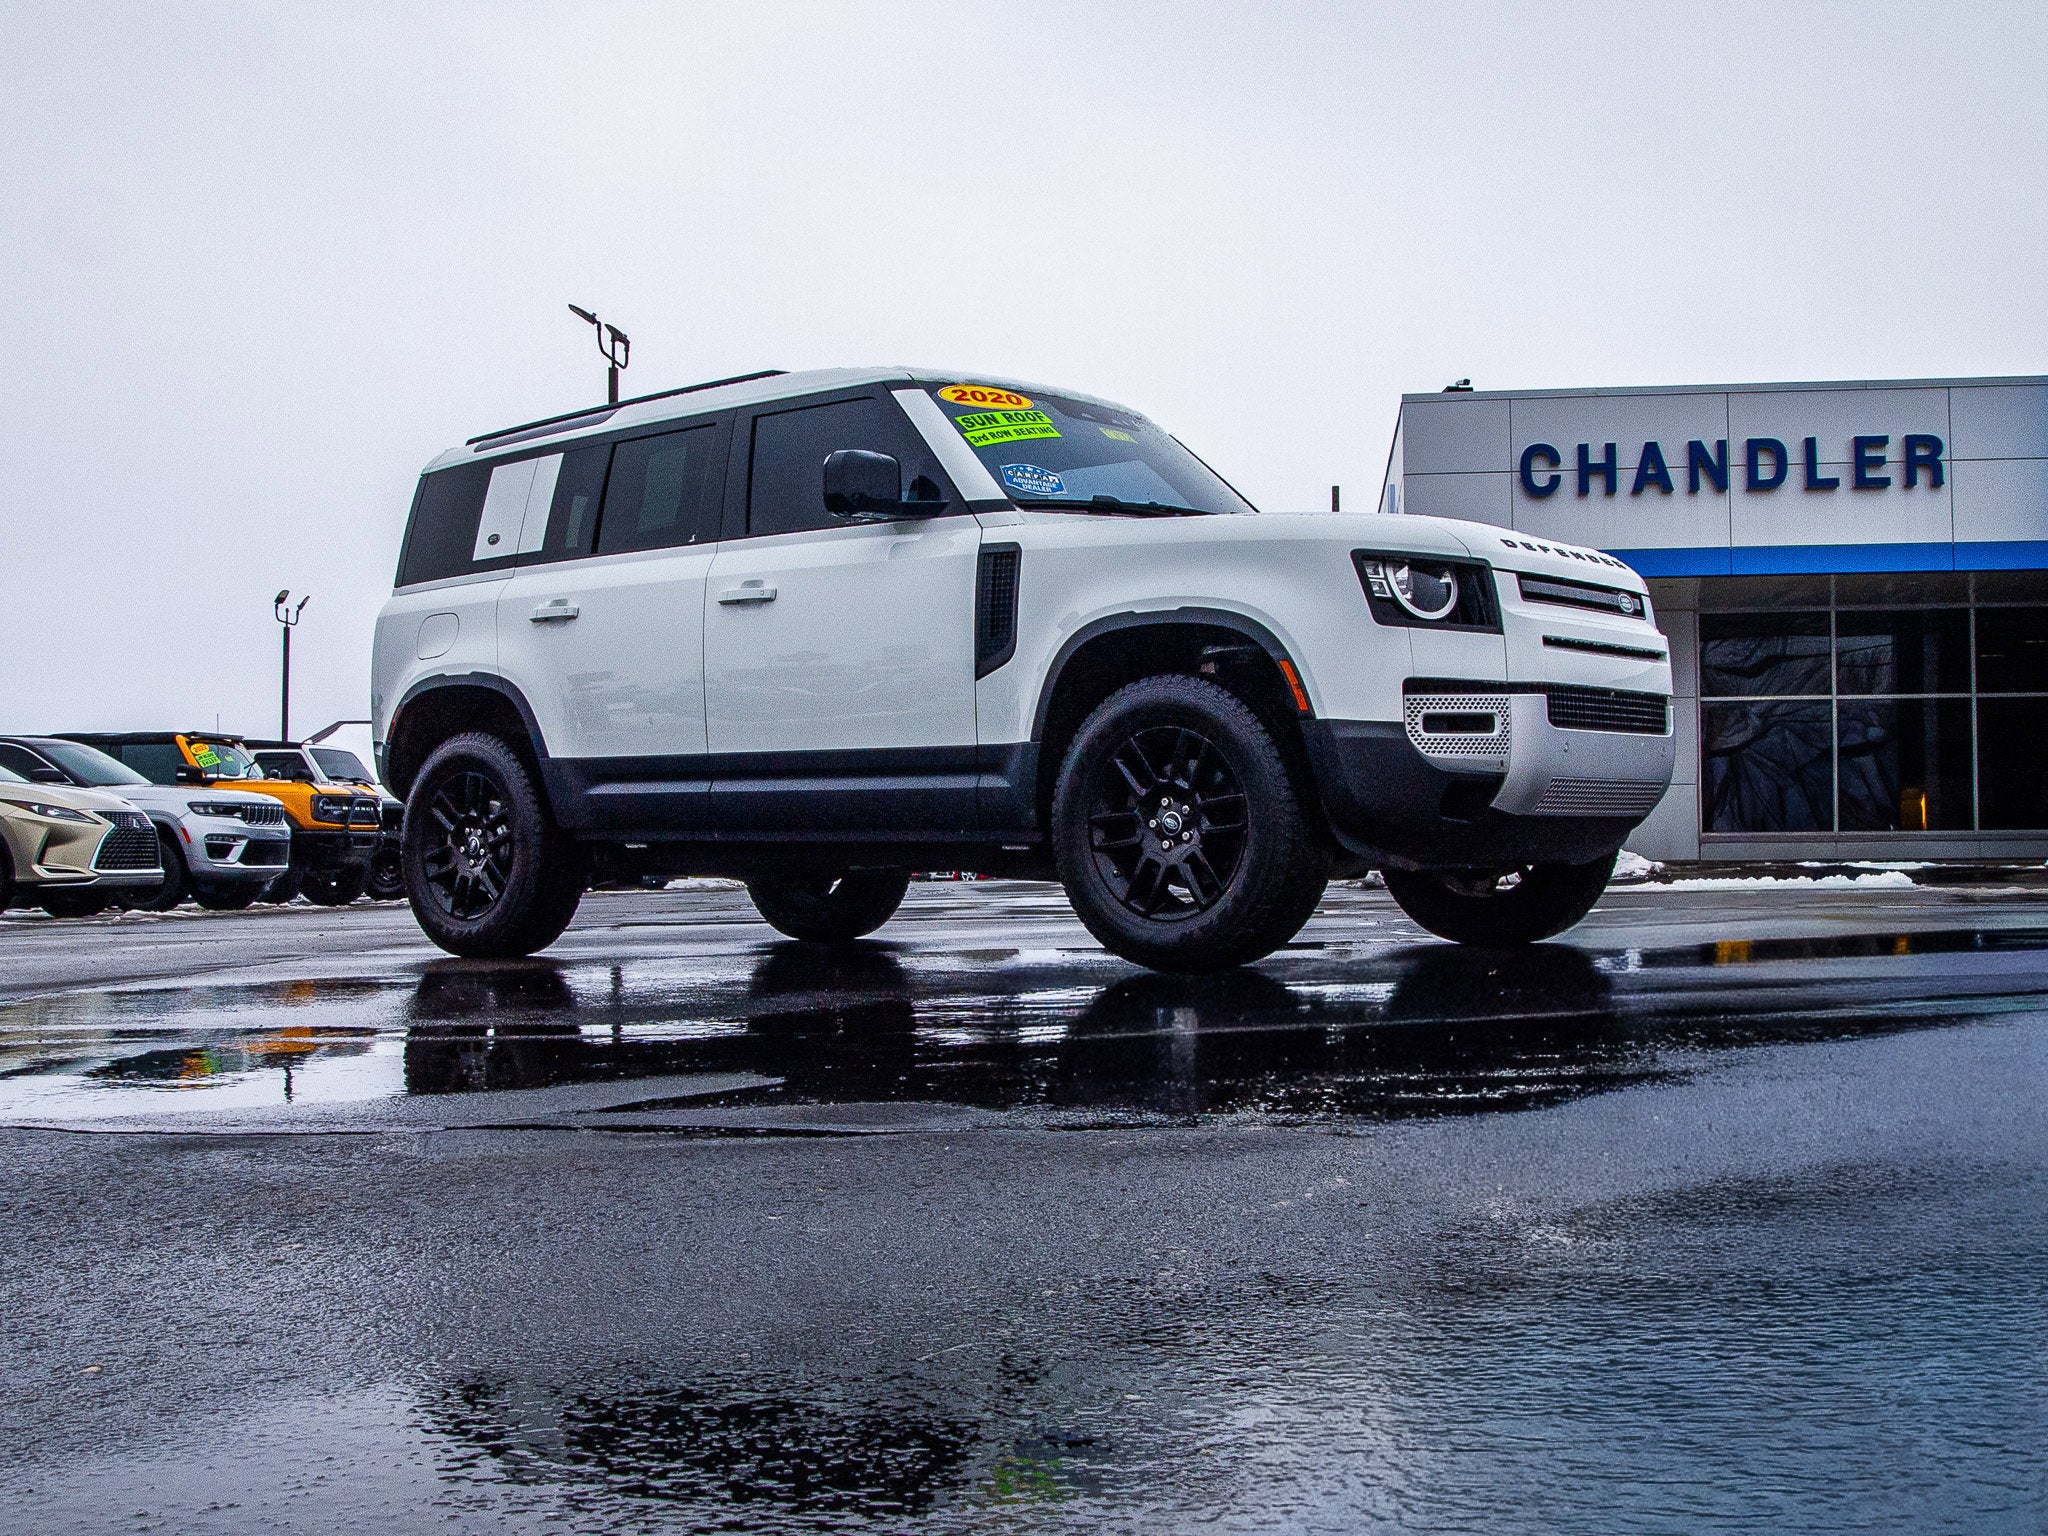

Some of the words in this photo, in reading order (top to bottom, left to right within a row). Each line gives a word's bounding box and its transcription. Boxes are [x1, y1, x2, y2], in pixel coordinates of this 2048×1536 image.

[951, 389, 1024, 406] 2020
[961, 413, 1000, 428] SUN
[1001, 411, 1045, 425] ROOF
[970, 433, 989, 444] 3rd
[988, 429, 1013, 440] ROW
[1014, 426, 1055, 438] SEATING
[1519, 434, 1946, 497] CHANDLER
[1012, 477, 1058, 489] ADVANTAGE
[1022, 483, 1053, 493] DEALER
[1500, 538, 1627, 570] DEFENDER
